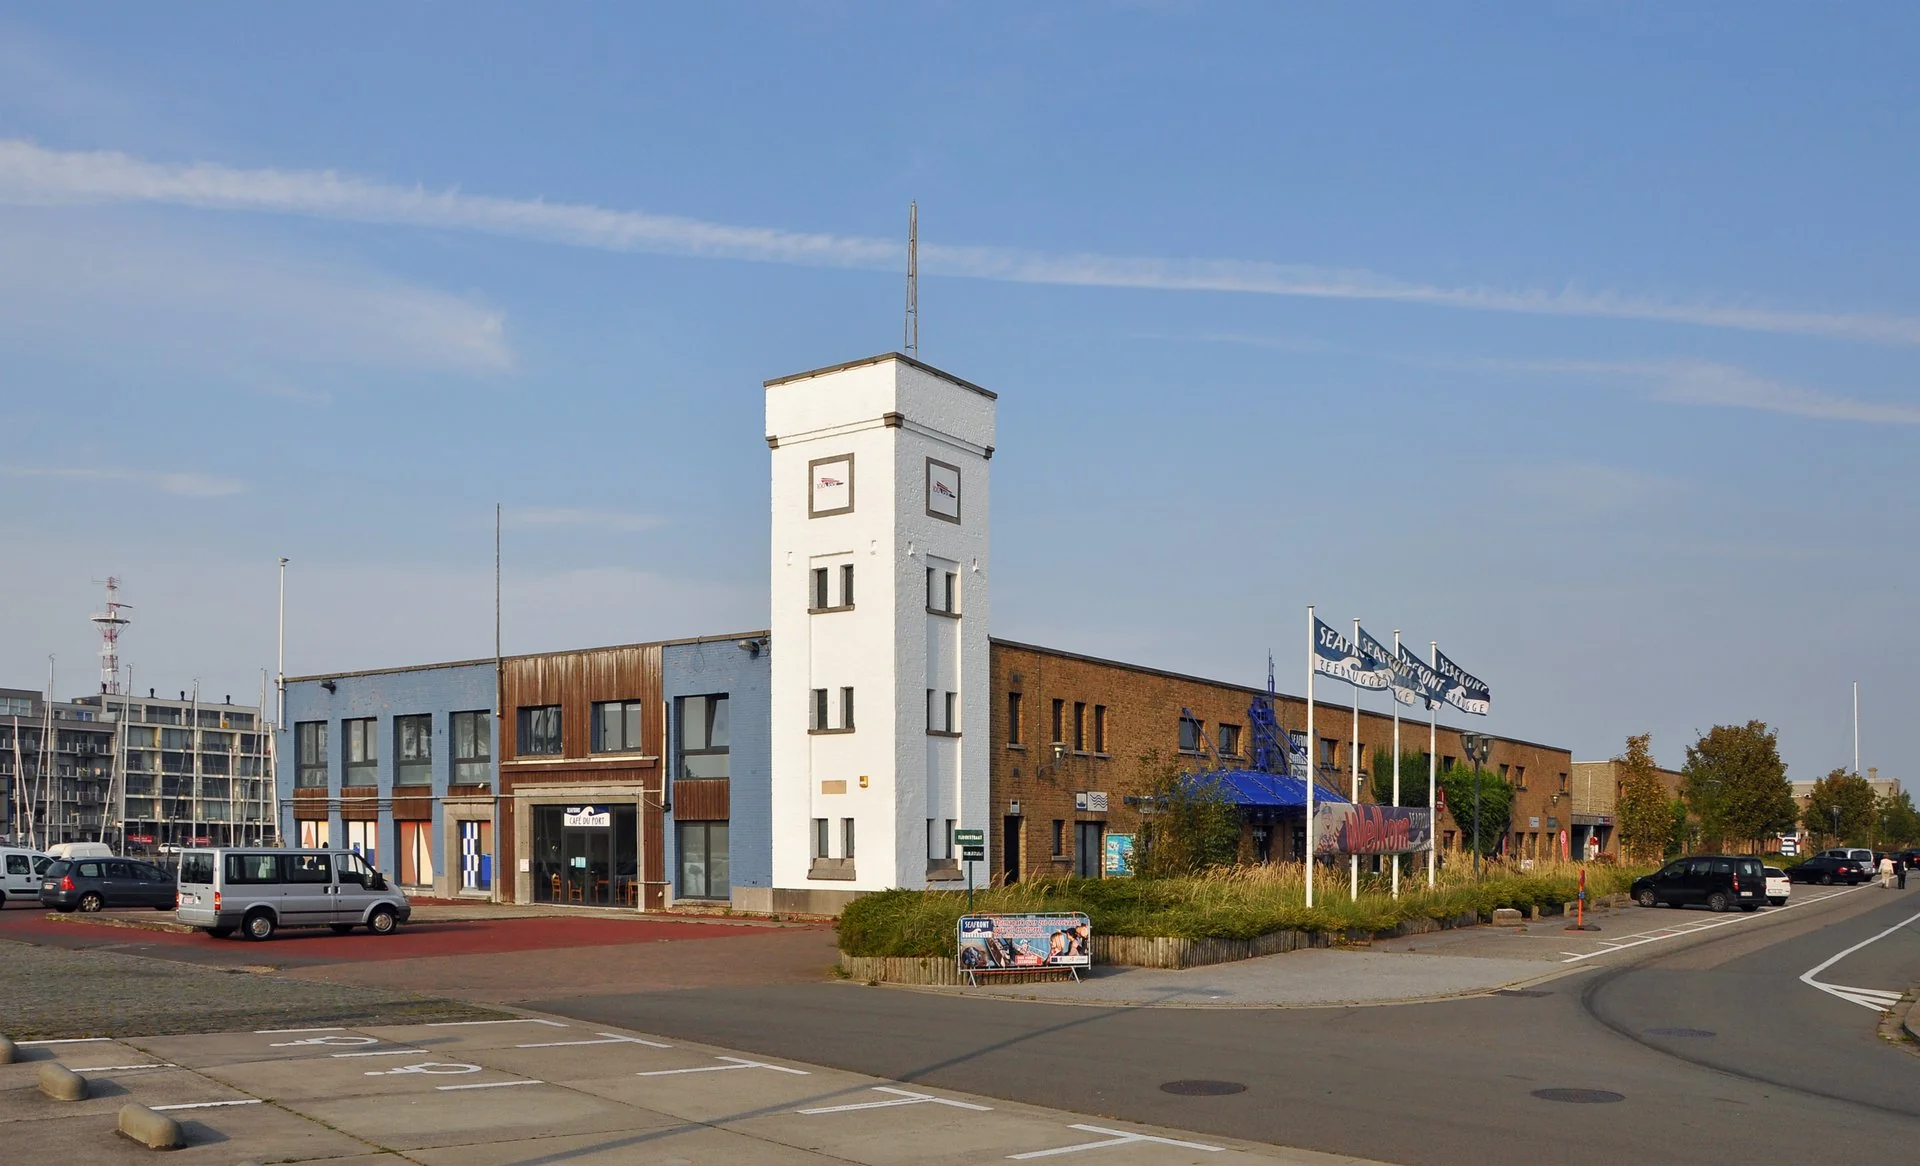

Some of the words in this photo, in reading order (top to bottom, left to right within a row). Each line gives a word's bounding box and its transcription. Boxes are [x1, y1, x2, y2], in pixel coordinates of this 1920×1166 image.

[1440, 658, 1487, 692] SEAFRONT
[583, 817, 591, 825] DU
[591, 816, 605, 825] PORT
[1344, 803, 1410, 855] Welkom
[964, 920, 990, 929] SEAFRONT
